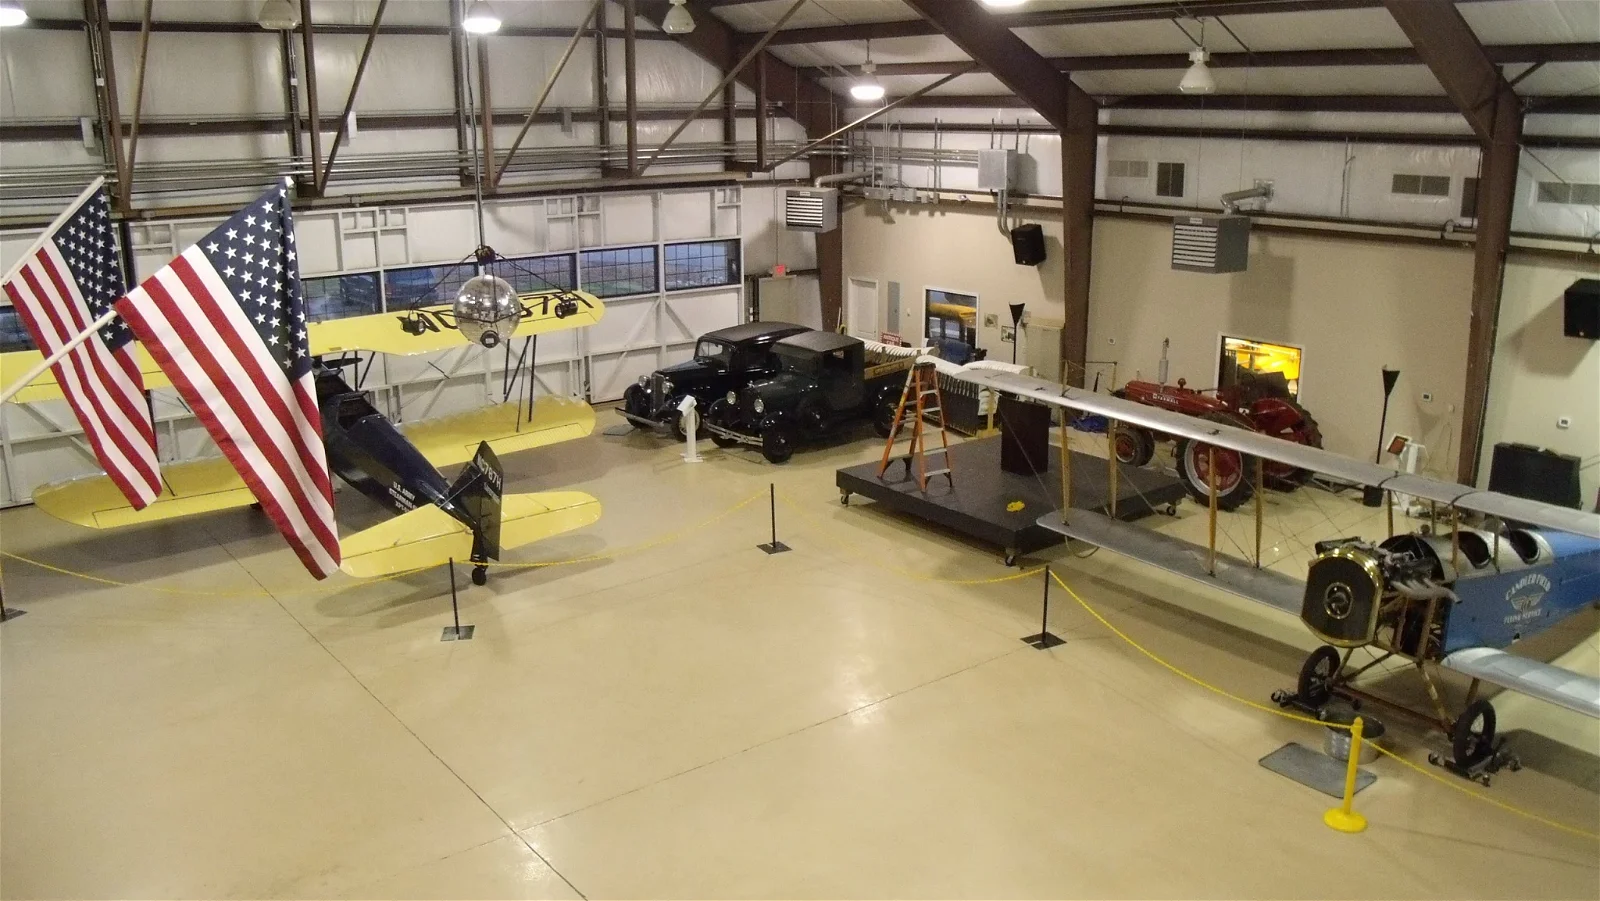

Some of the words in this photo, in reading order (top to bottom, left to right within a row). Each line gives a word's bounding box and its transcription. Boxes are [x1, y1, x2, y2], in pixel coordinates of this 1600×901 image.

[477, 453, 502, 490] NC787H
[402, 487, 416, 500] ARMY
[1505, 574, 1536, 601] CANDLER
[1536, 574, 1551, 592] FIELD
[1503, 614, 1521, 625] FLYING
[1521, 608, 1542, 620] SERVICE
